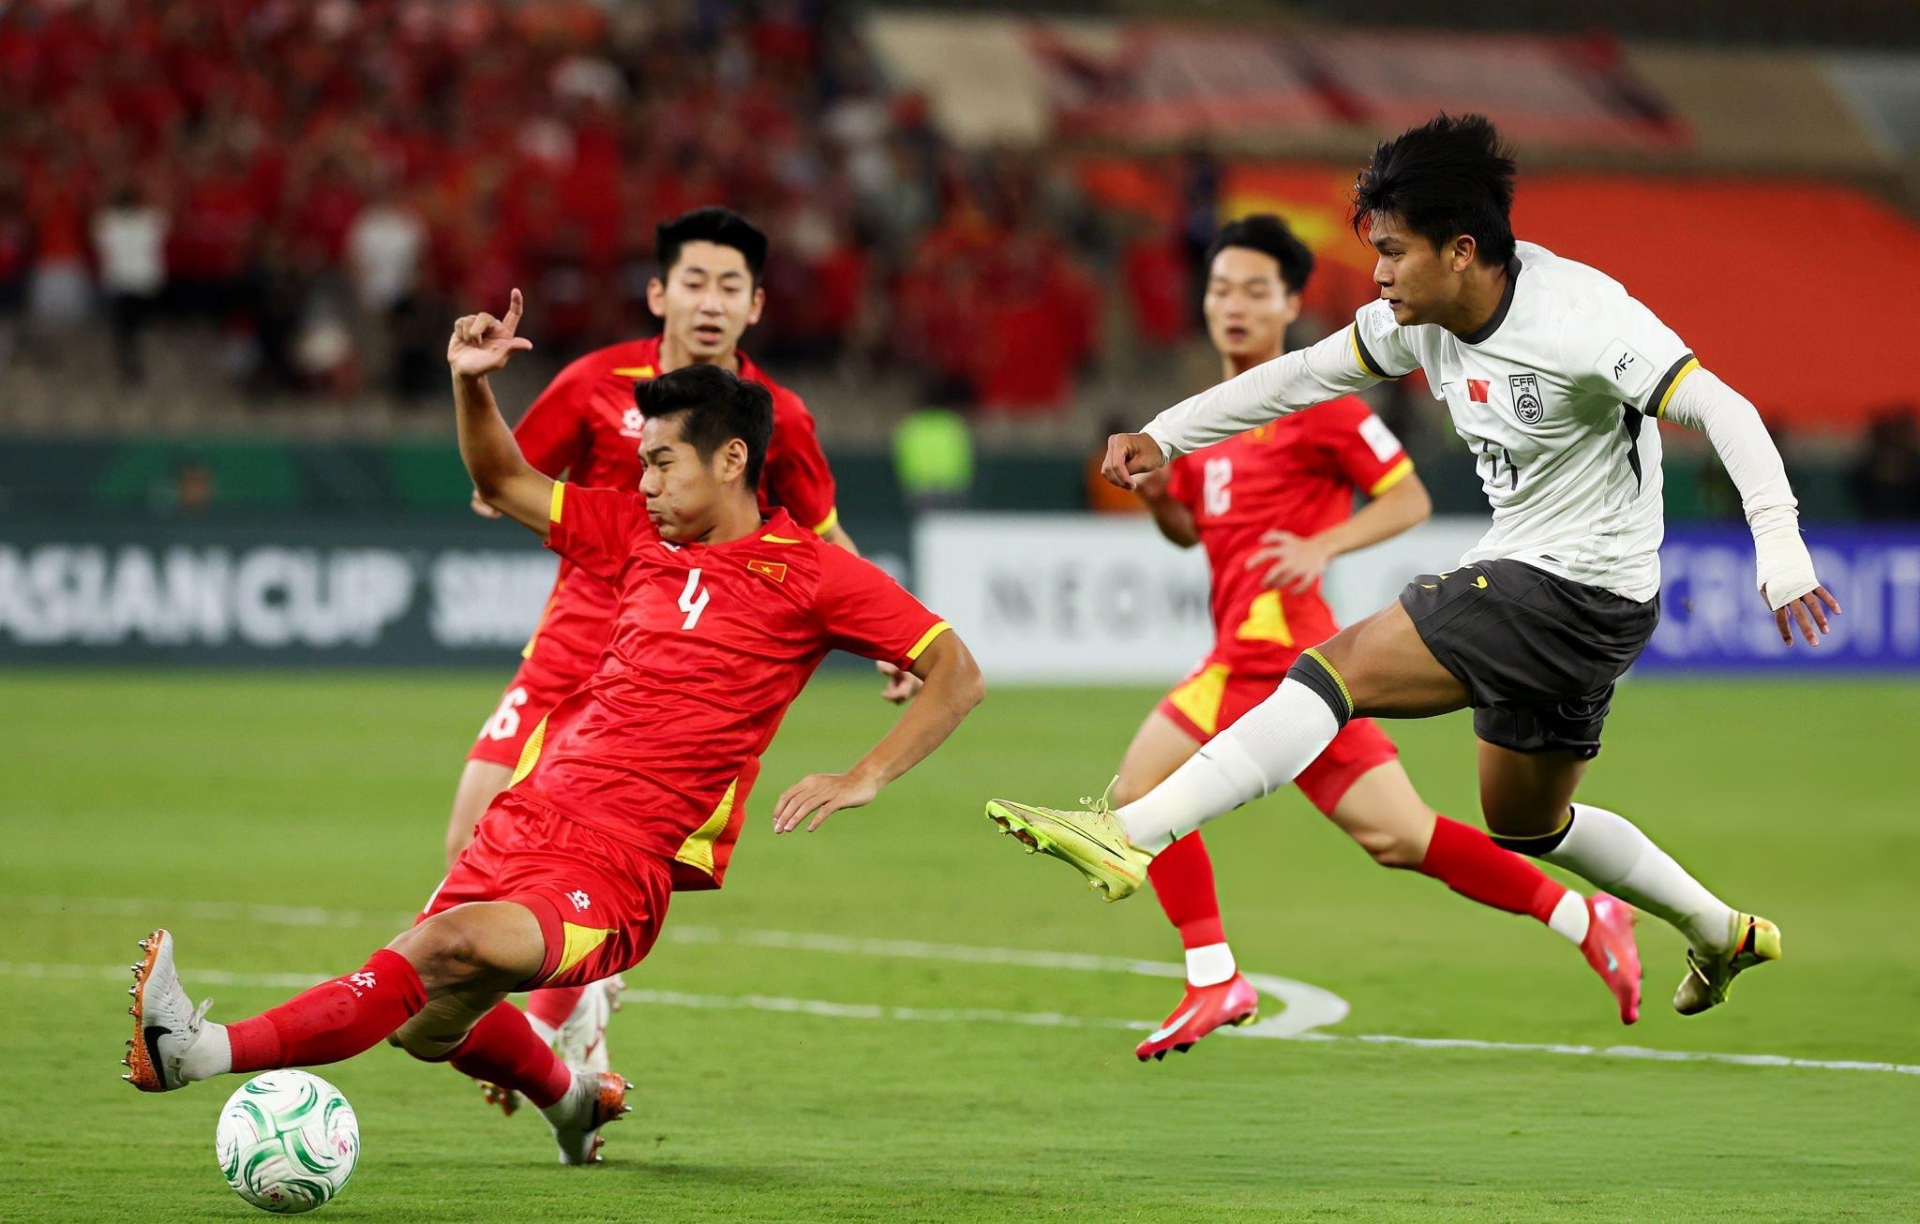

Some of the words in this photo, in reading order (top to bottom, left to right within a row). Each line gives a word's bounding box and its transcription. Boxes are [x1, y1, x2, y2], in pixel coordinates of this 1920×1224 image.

[1511, 377, 1536, 388] CFA
[1613, 351, 1635, 381] AFC
[237, 547, 412, 648] CUP
[677, 567, 711, 630] 4
